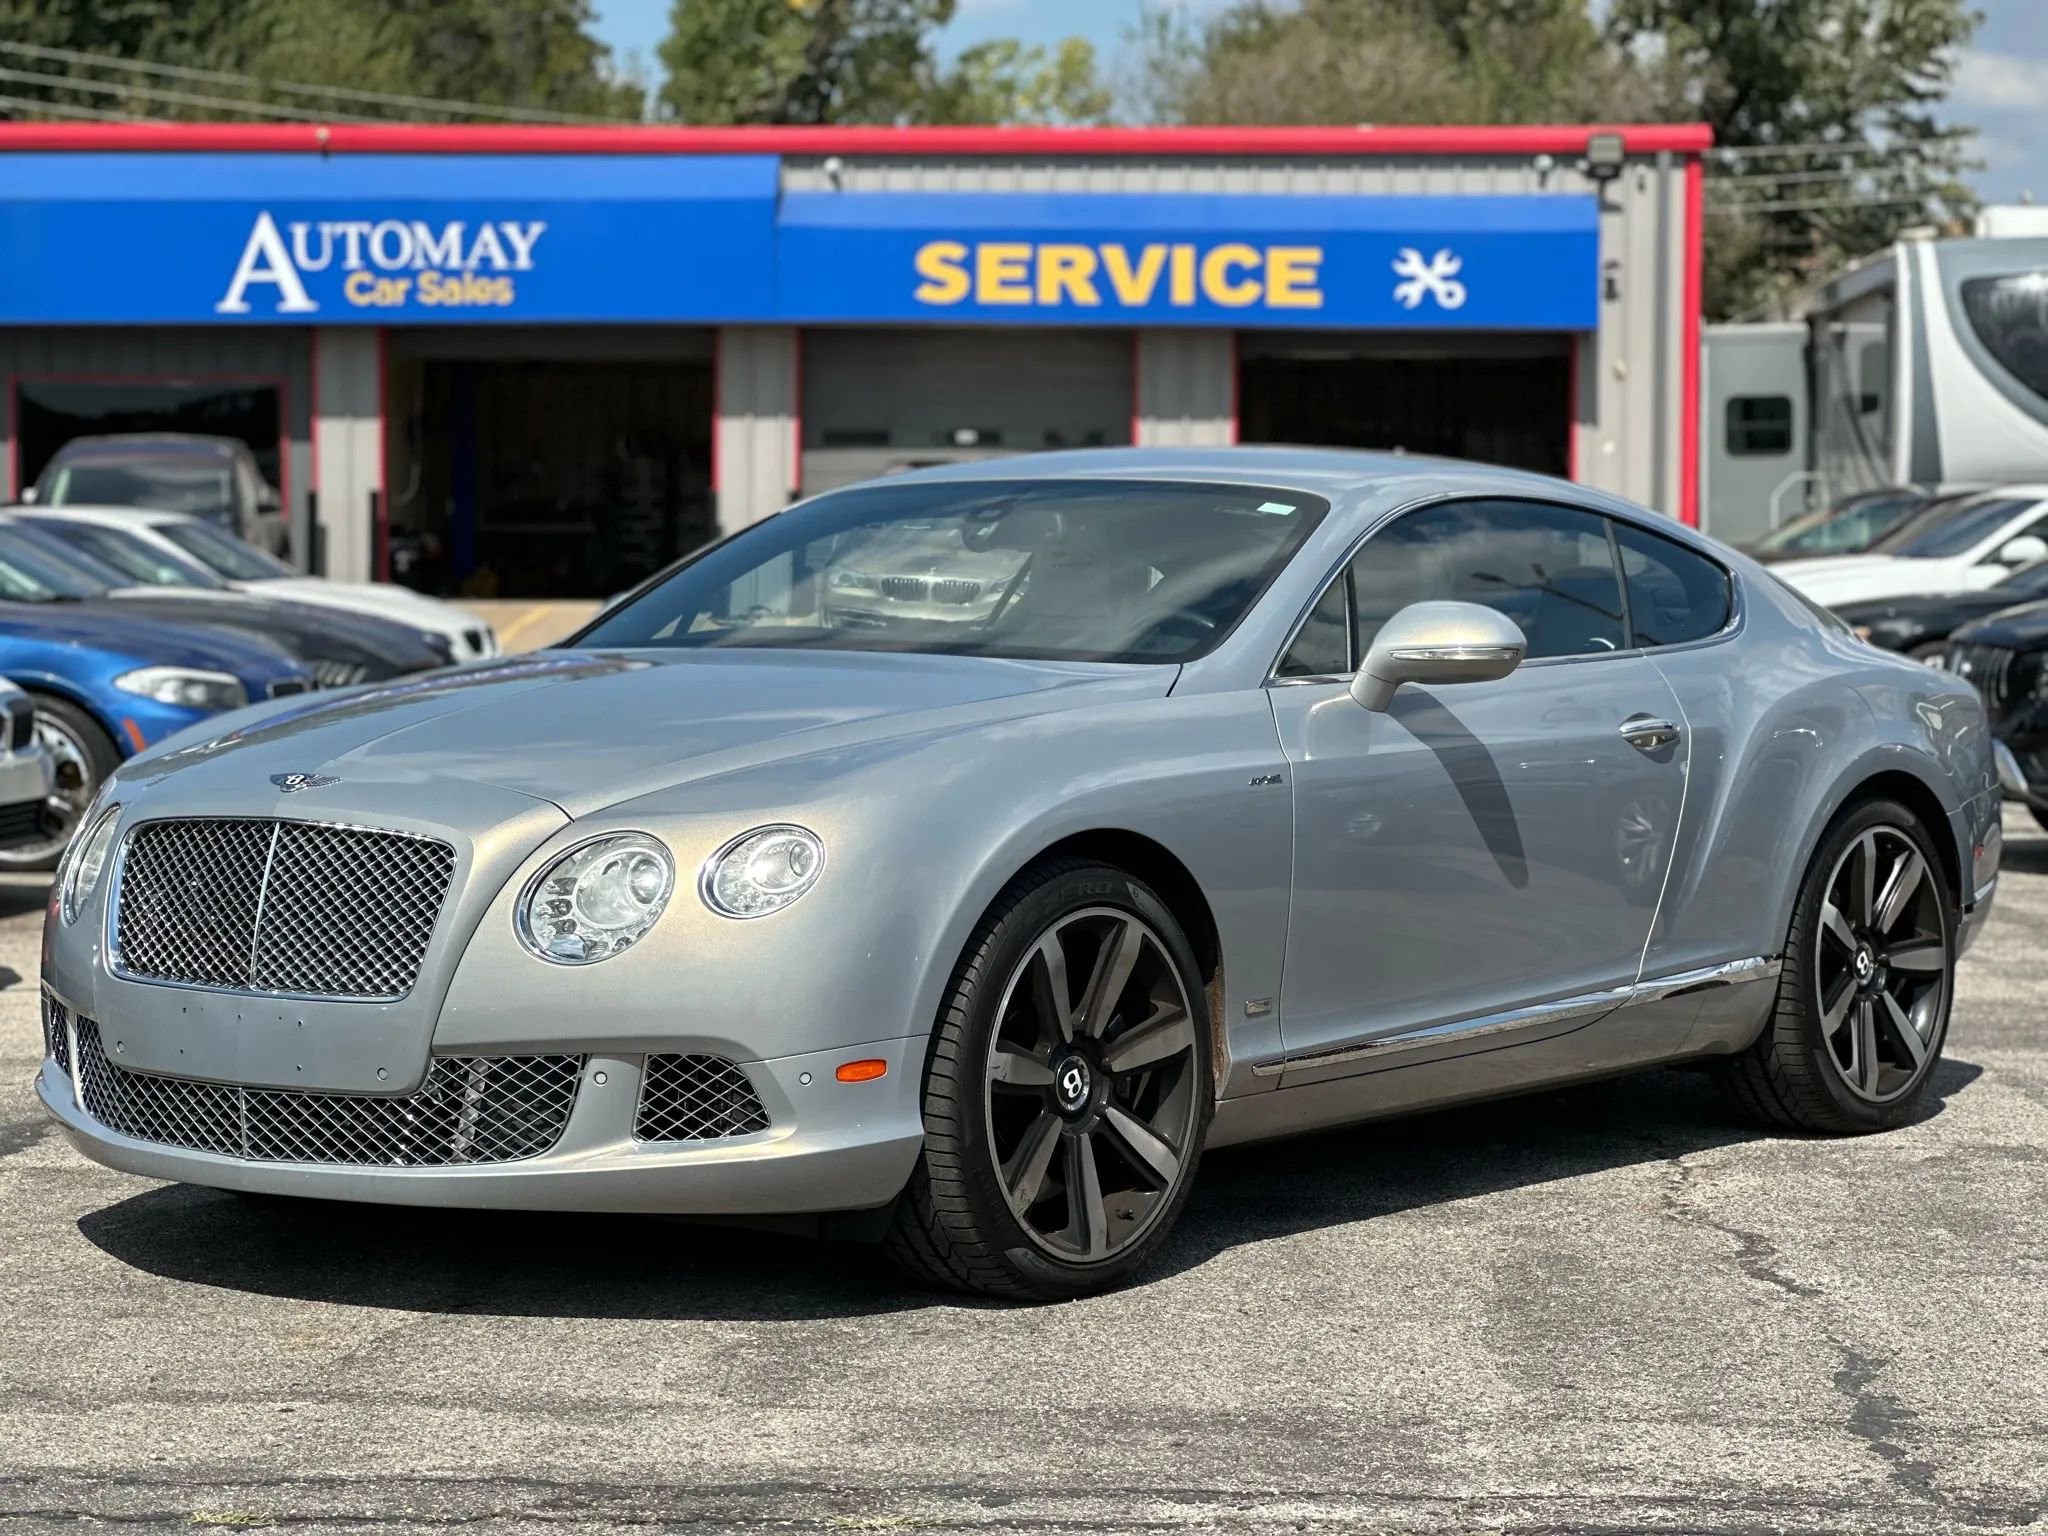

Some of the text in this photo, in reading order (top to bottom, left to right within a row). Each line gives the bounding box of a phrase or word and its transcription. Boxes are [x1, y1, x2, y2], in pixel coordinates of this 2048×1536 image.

[214, 210, 547, 313] AUTOMAY
[914, 241, 1323, 307] SERVICE
[344, 271, 514, 305] Car Sales
[1063, 1068, 1082, 1098] B
